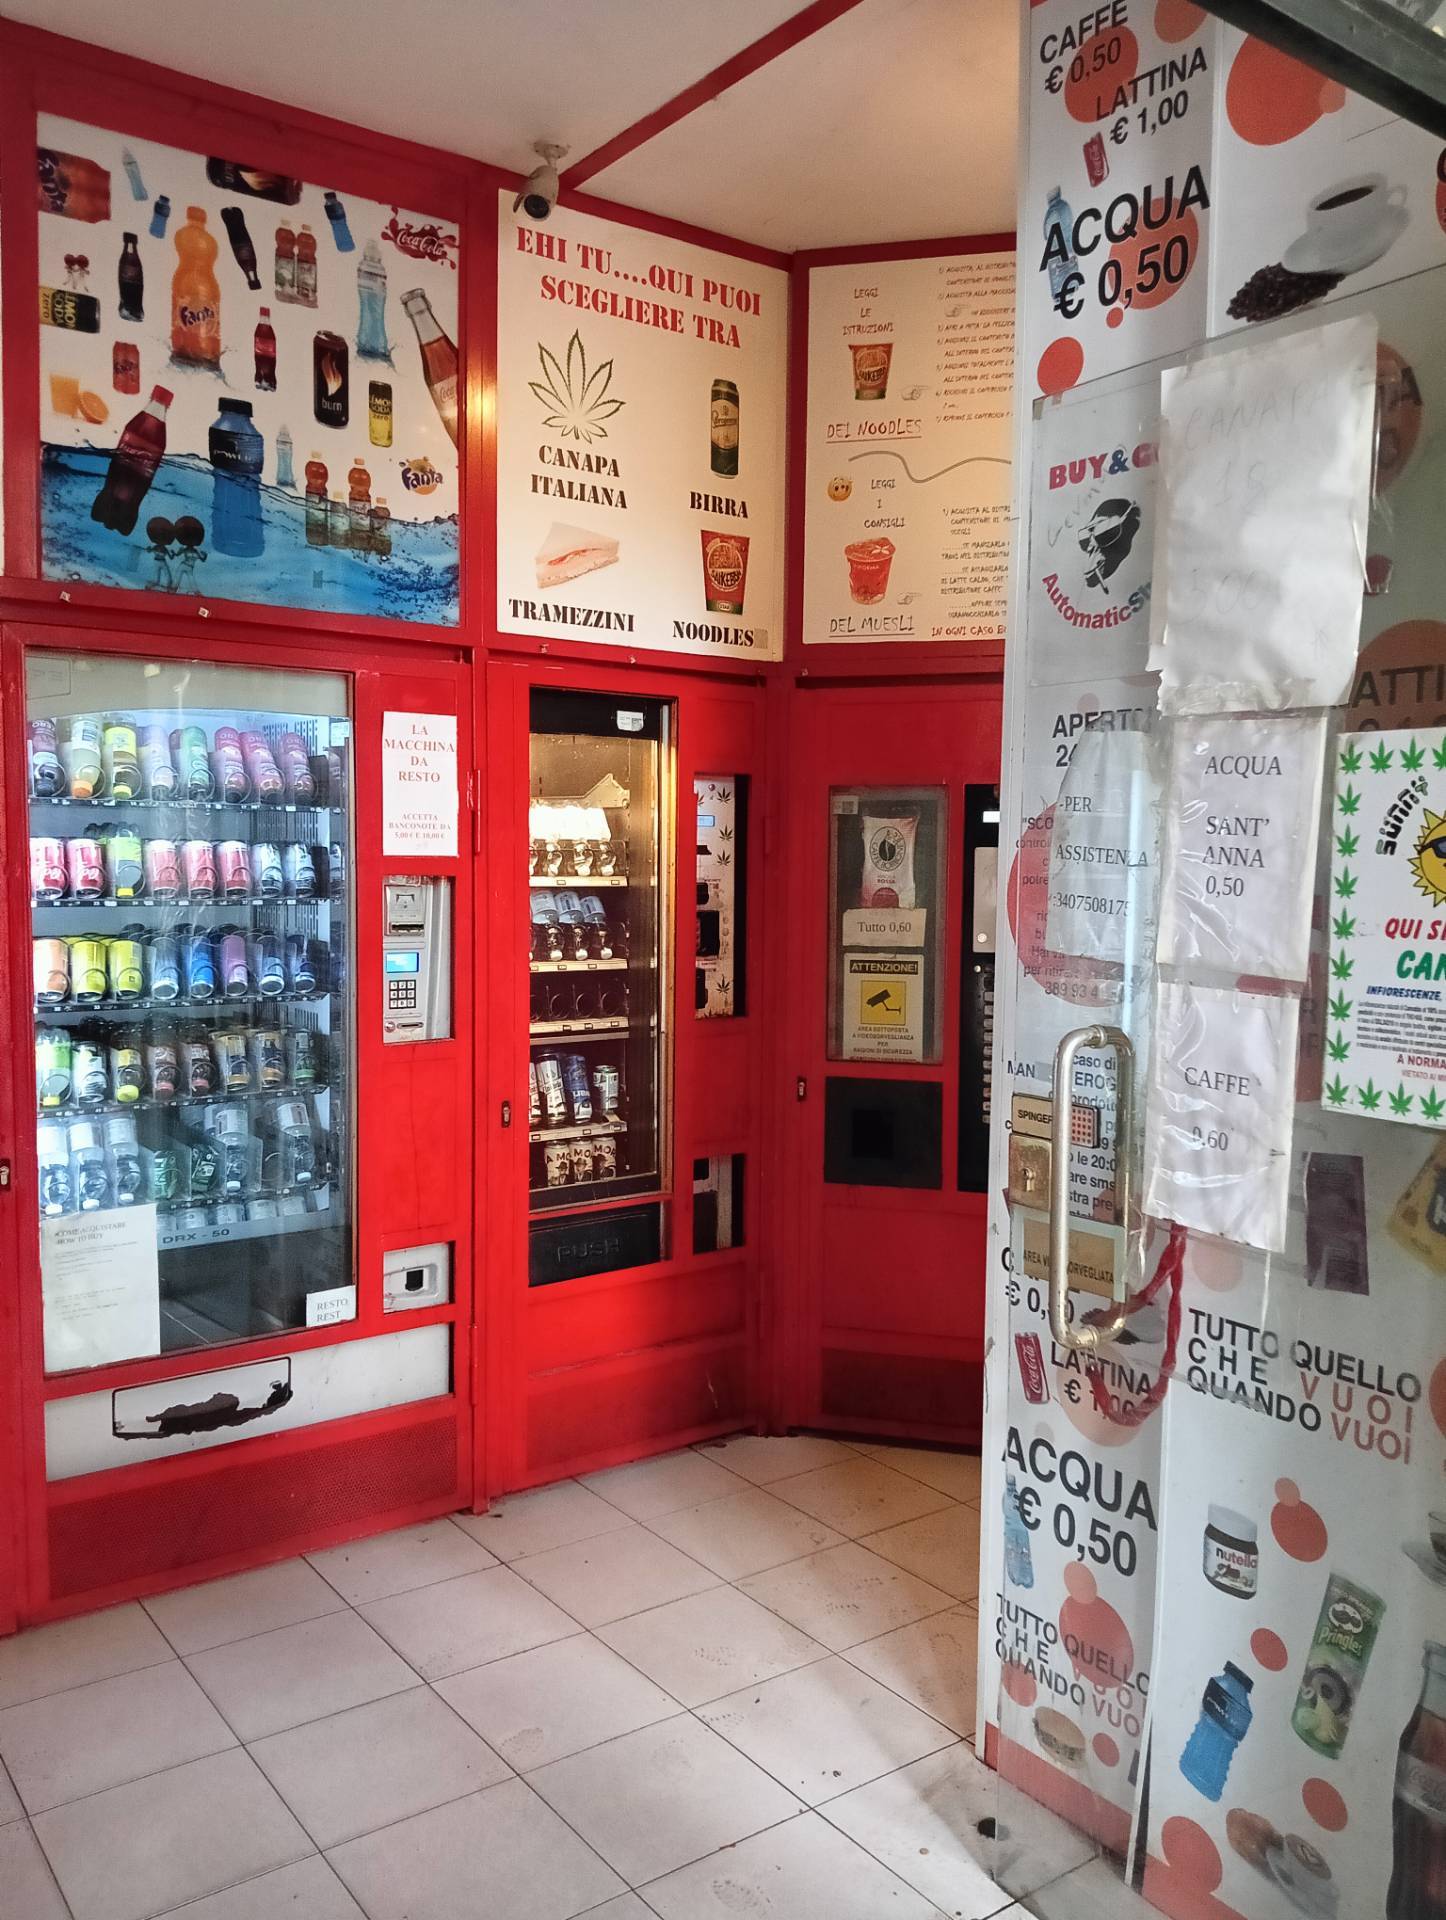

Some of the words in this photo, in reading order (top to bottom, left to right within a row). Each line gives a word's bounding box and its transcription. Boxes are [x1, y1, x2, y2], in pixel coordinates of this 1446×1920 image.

[1045, 66, 1063, 94] €
[1095, 47, 1208, 121] LATTINA
[1110, 117, 1128, 145] €
[1138, 89, 1189, 136] 1,00
[1039, 165, 1210, 272] ACQUA
[516, 227, 567, 264] EHI
[703, 278, 761, 317] PUOI
[1053, 271, 1085, 320] €
[1099, 235, 1189, 310] 0,50
[854, 288, 879, 299] LEGGI
[180, 305, 216, 327] Fanta
[540, 275, 684, 334] SCEGLIERE
[693, 315, 740, 348] TRA
[860, 307, 871, 317] LE
[842, 322, 894, 336] ISTRUZIONI
[322, 398, 342, 411] burn
[857, 419, 922, 436] NOODLES
[539, 445, 620, 478] CANAPA
[1049, 442, 1160, 490] BUY&G
[401, 467, 443, 490] Fanta
[871, 478, 896, 489] LEGGI
[531, 475, 627, 509] ITALIANA
[690, 492, 748, 519] BIRRA
[864, 517, 905, 528] CONSIGLI
[508, 598, 635, 632] TRAMEZZINI
[830, 618, 856, 633] DEL
[861, 615, 915, 632] MUESLI
[672, 620, 754, 648] NOODLES
[932, 626, 942, 636] IN
[946, 626, 966, 636] OGNI
[970, 625, 993, 635] CASO
[412, 724, 428, 735] LA
[384, 738, 455, 753] MACCHINA
[410, 755, 428, 767] DA
[1204, 755, 1282, 779] ACQUA
[398, 771, 441, 783] RESTO
[389, 822, 438, 830] BANCONOTE
[402, 813, 438, 821] ACCETTA
[1202, 845, 1265, 868] ANNA
[1205, 875, 1244, 898] 0,50
[857, 920, 887, 934] Tutto
[889, 920, 912, 934] 0,60
[1385, 917, 1423, 940] QUI
[851, 961, 918, 974] ATTENZIONE!
[1105, 1055, 1116, 1070] di
[1184, 1066, 1251, 1097] CAFFE
[78, 1235, 87, 1243] TO
[88, 1233, 104, 1241] BUY
[162, 1232, 197, 1246] DRX
[212, 1228, 230, 1240] 50
[316, 1298, 349, 1311] RESTO
[316, 1310, 342, 1323] REST
[1188, 1307, 1279, 1359] TUTTO
[1294, 1340, 1422, 1403] QUELLO
[1064, 1378, 1081, 1404] €
[1187, 1365, 1321, 1432] QUANDO
[1331, 1413, 1413, 1465] VUOI
[1001, 1426, 1158, 1531] ACQUA
[1014, 1486, 1042, 1531] €
[1053, 1503, 1137, 1577] 0,50
[1216, 1547, 1257, 1569] nutella
[996, 1592, 1058, 1645] TUTTO
[1318, 1626, 1364, 1657] Pringles
[996, 1638, 1085, 1706] QUANDO
